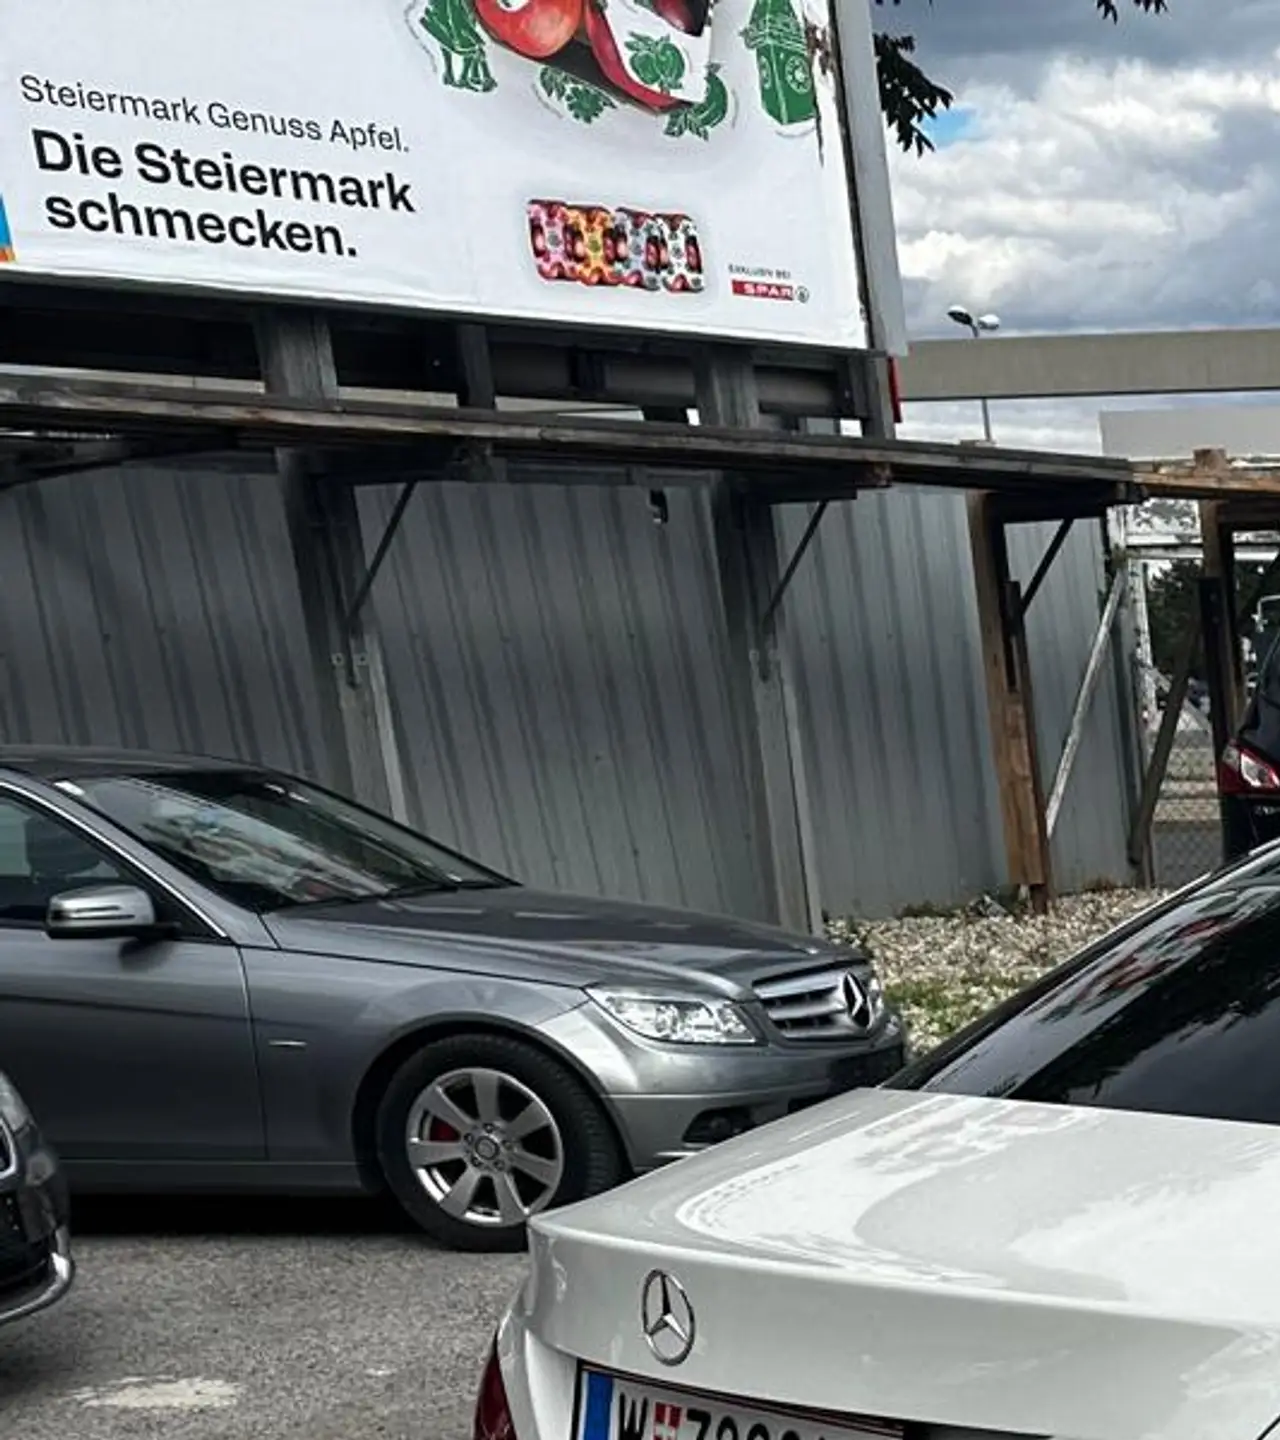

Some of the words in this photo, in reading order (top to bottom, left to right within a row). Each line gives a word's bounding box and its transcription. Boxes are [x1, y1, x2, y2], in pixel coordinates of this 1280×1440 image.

[20, 74, 201, 125] Steiermark
[207, 102, 322, 141] Genuss
[329, 119, 409, 152] Apfel.
[32, 128, 123, 179] Die
[134, 142, 416, 213] Steiermark
[45, 192, 357, 257] schmecken.
[743, 283, 791, 297] SPAR
